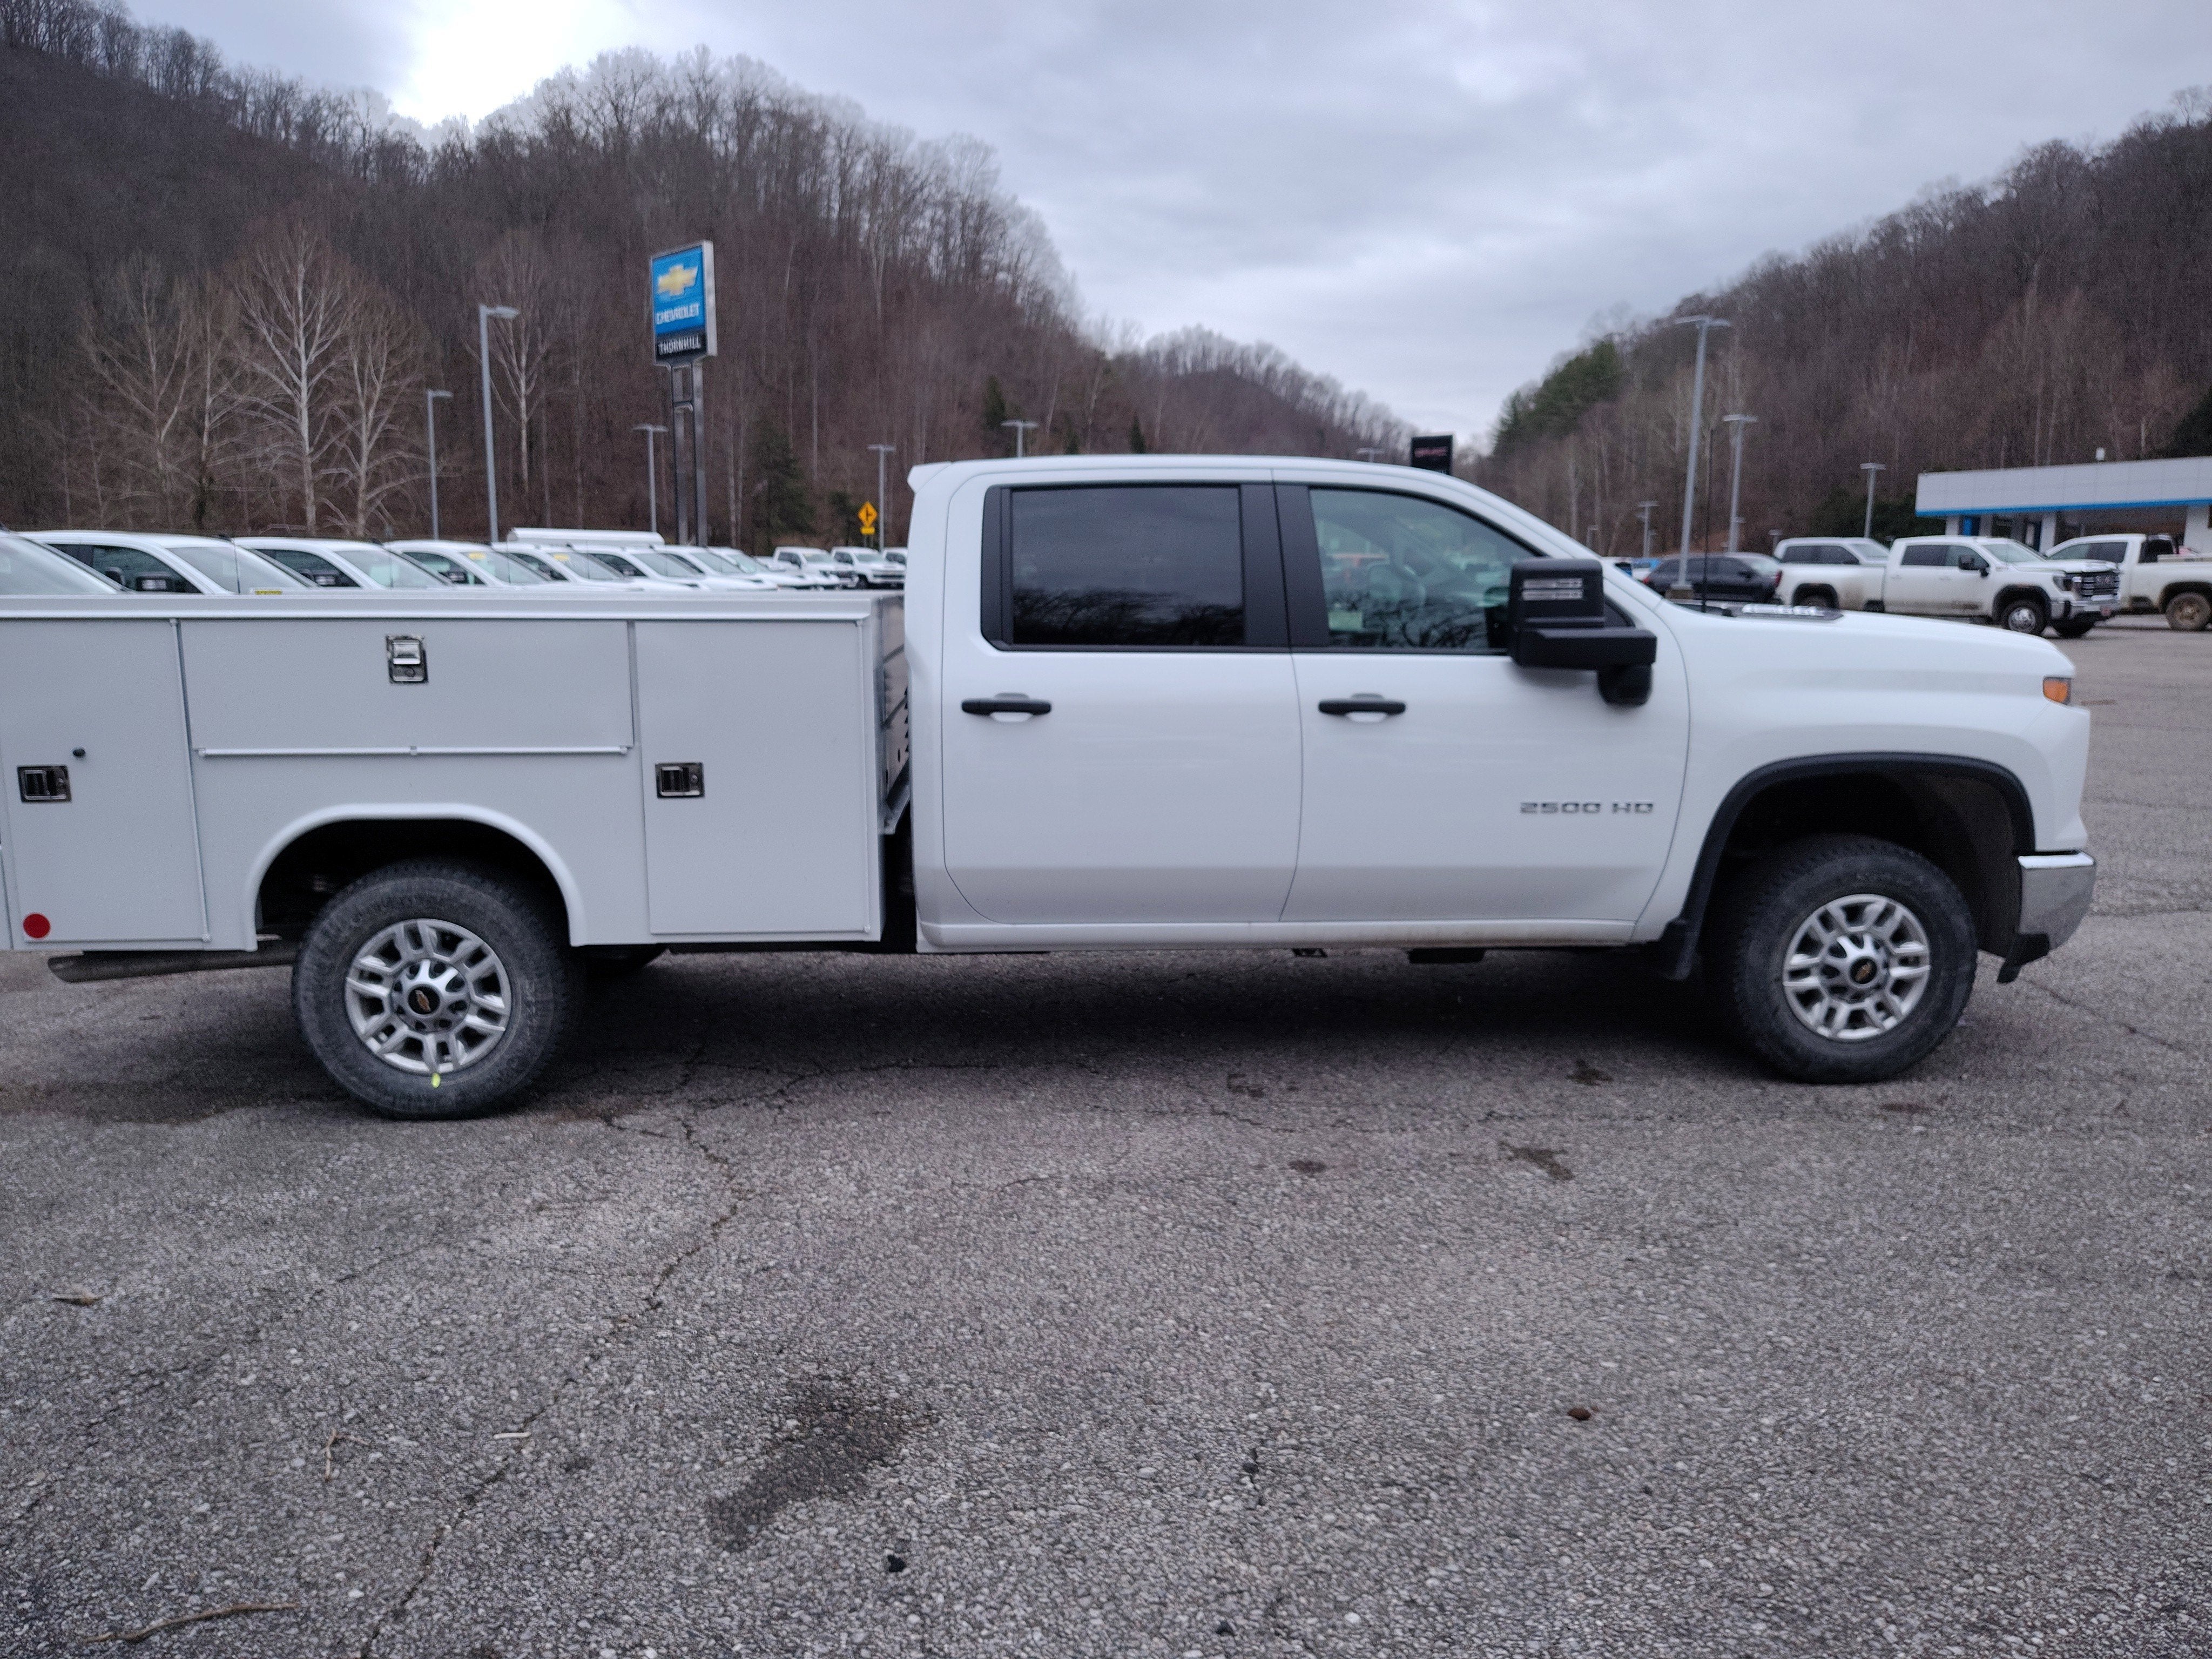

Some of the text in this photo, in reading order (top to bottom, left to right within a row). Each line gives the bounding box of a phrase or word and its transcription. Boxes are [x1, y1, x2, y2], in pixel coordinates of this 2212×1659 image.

[656, 303, 699, 324] CHEVROLET
[658, 335, 701, 355] THORNHILL
[1520, 802, 1654, 814] 2500 HD
